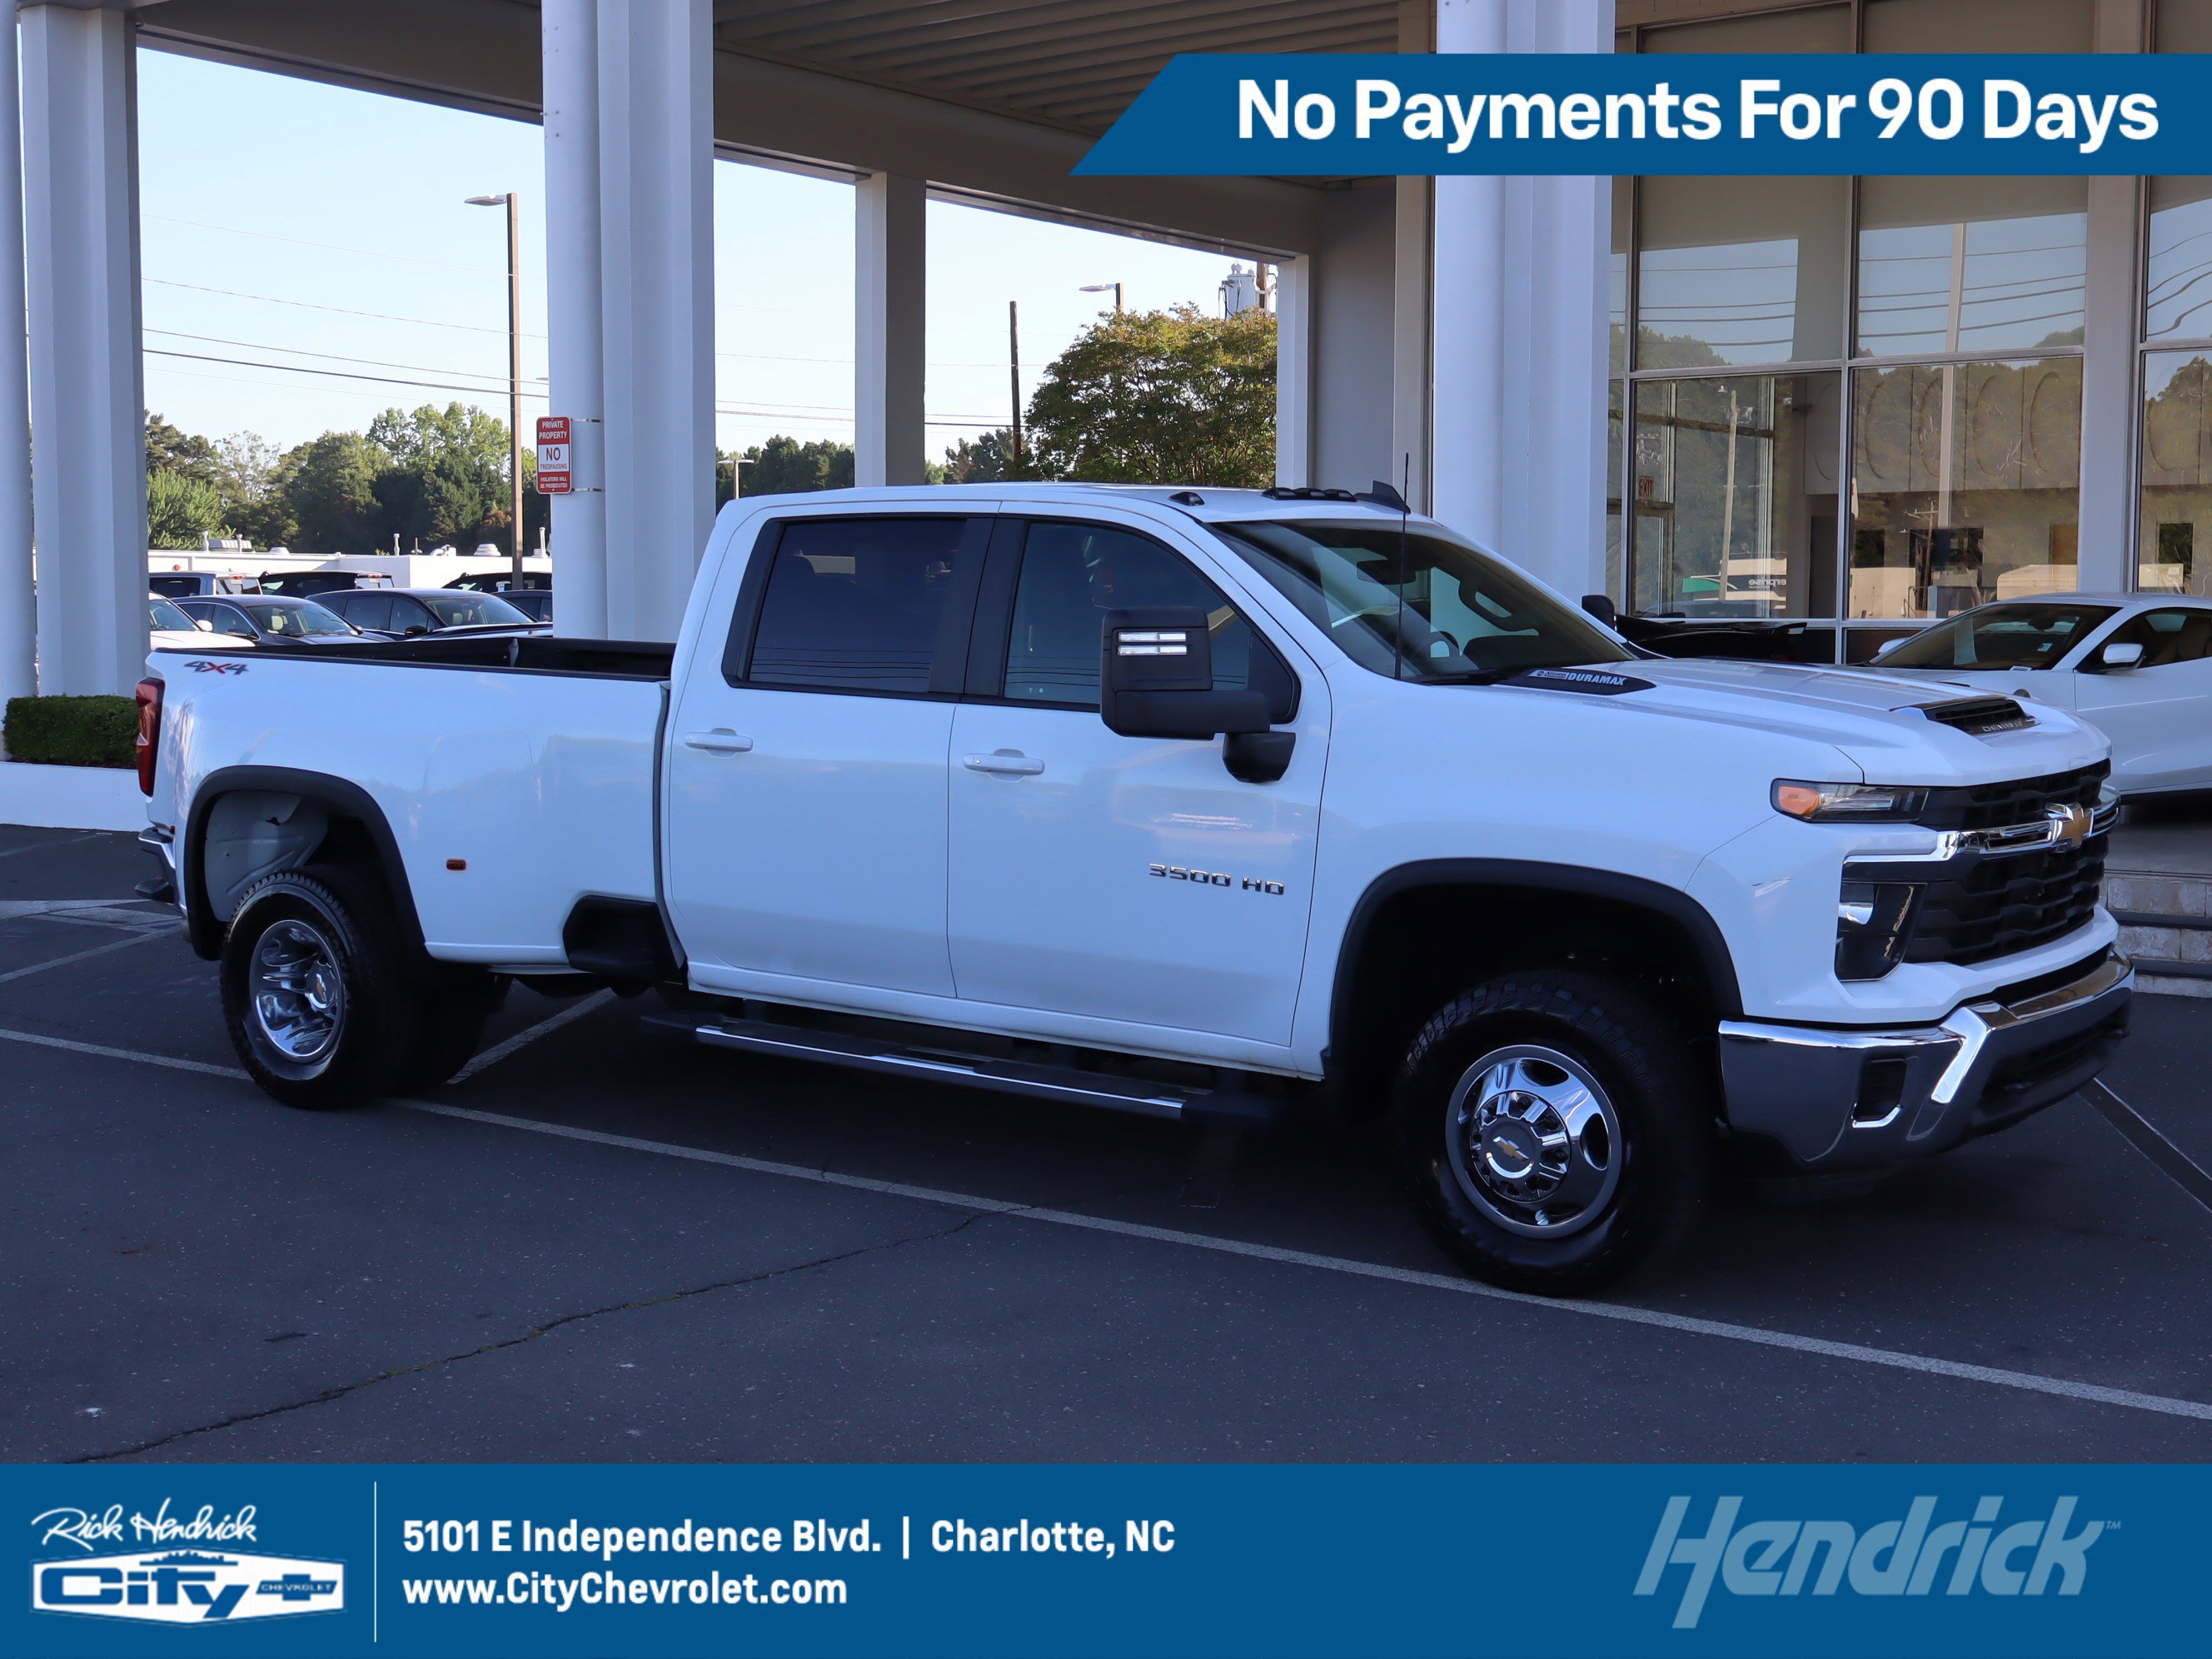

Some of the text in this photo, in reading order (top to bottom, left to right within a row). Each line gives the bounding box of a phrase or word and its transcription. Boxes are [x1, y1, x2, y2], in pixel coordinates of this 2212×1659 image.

[541, 421, 564, 429] PRIVATE
[539, 431, 567, 440] PROPERTY
[546, 447, 560, 461] NO
[1568, 672, 1627, 685] DURAMAX
[1149, 863, 1284, 895] 3500 HD
